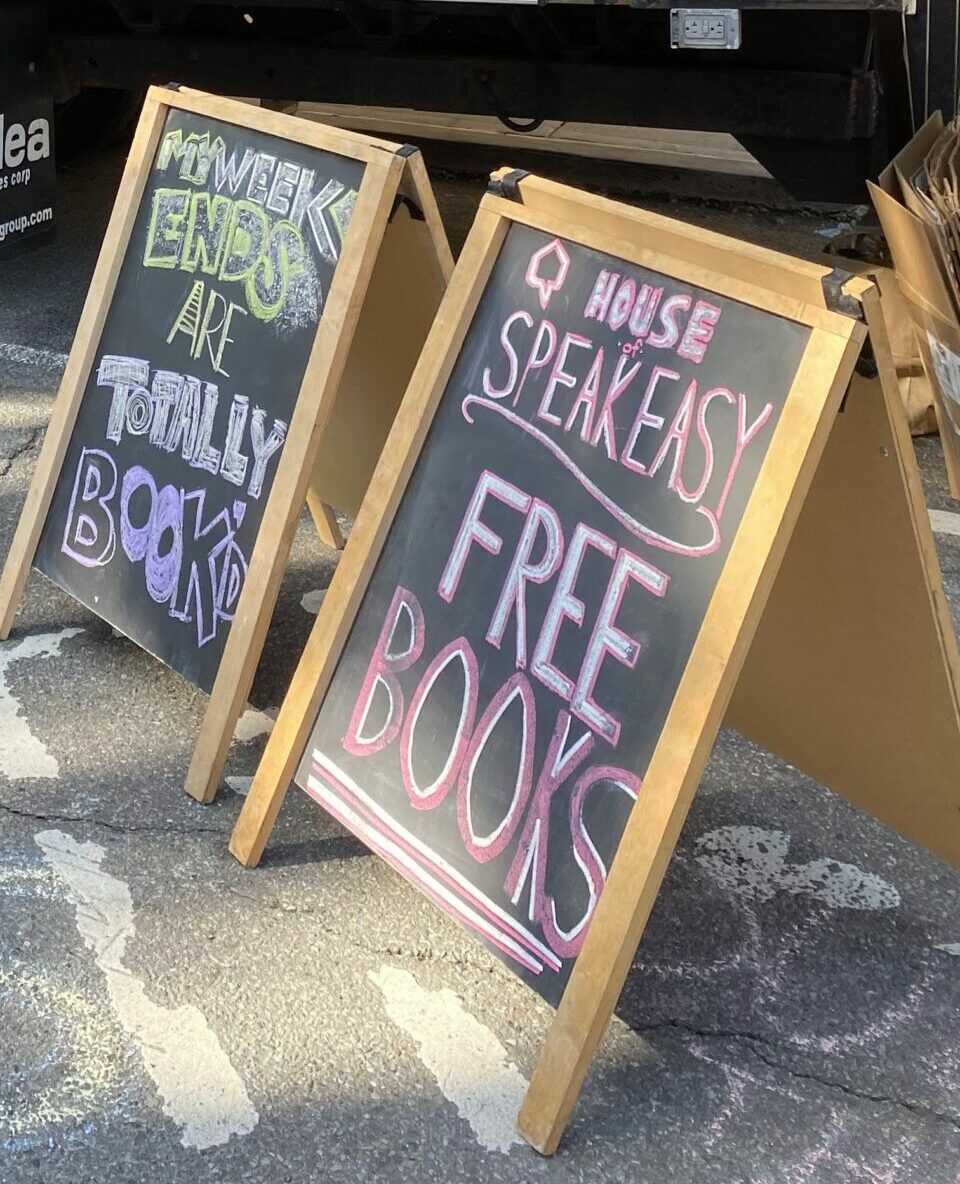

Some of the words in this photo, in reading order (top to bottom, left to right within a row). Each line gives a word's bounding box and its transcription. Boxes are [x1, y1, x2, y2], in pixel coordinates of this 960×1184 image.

[11, 168, 31, 186] corp
[143, 187, 305, 322] ENDS
[584, 269, 722, 364] HOUSE
[166, 279, 248, 378] ARE
[622, 337, 643, 358] of
[96, 354, 288, 500] TOTALLY
[482, 310, 774, 518] SPEAKEASY
[438, 469, 671, 748] FREE
[342, 585, 642, 959] BOOKS
